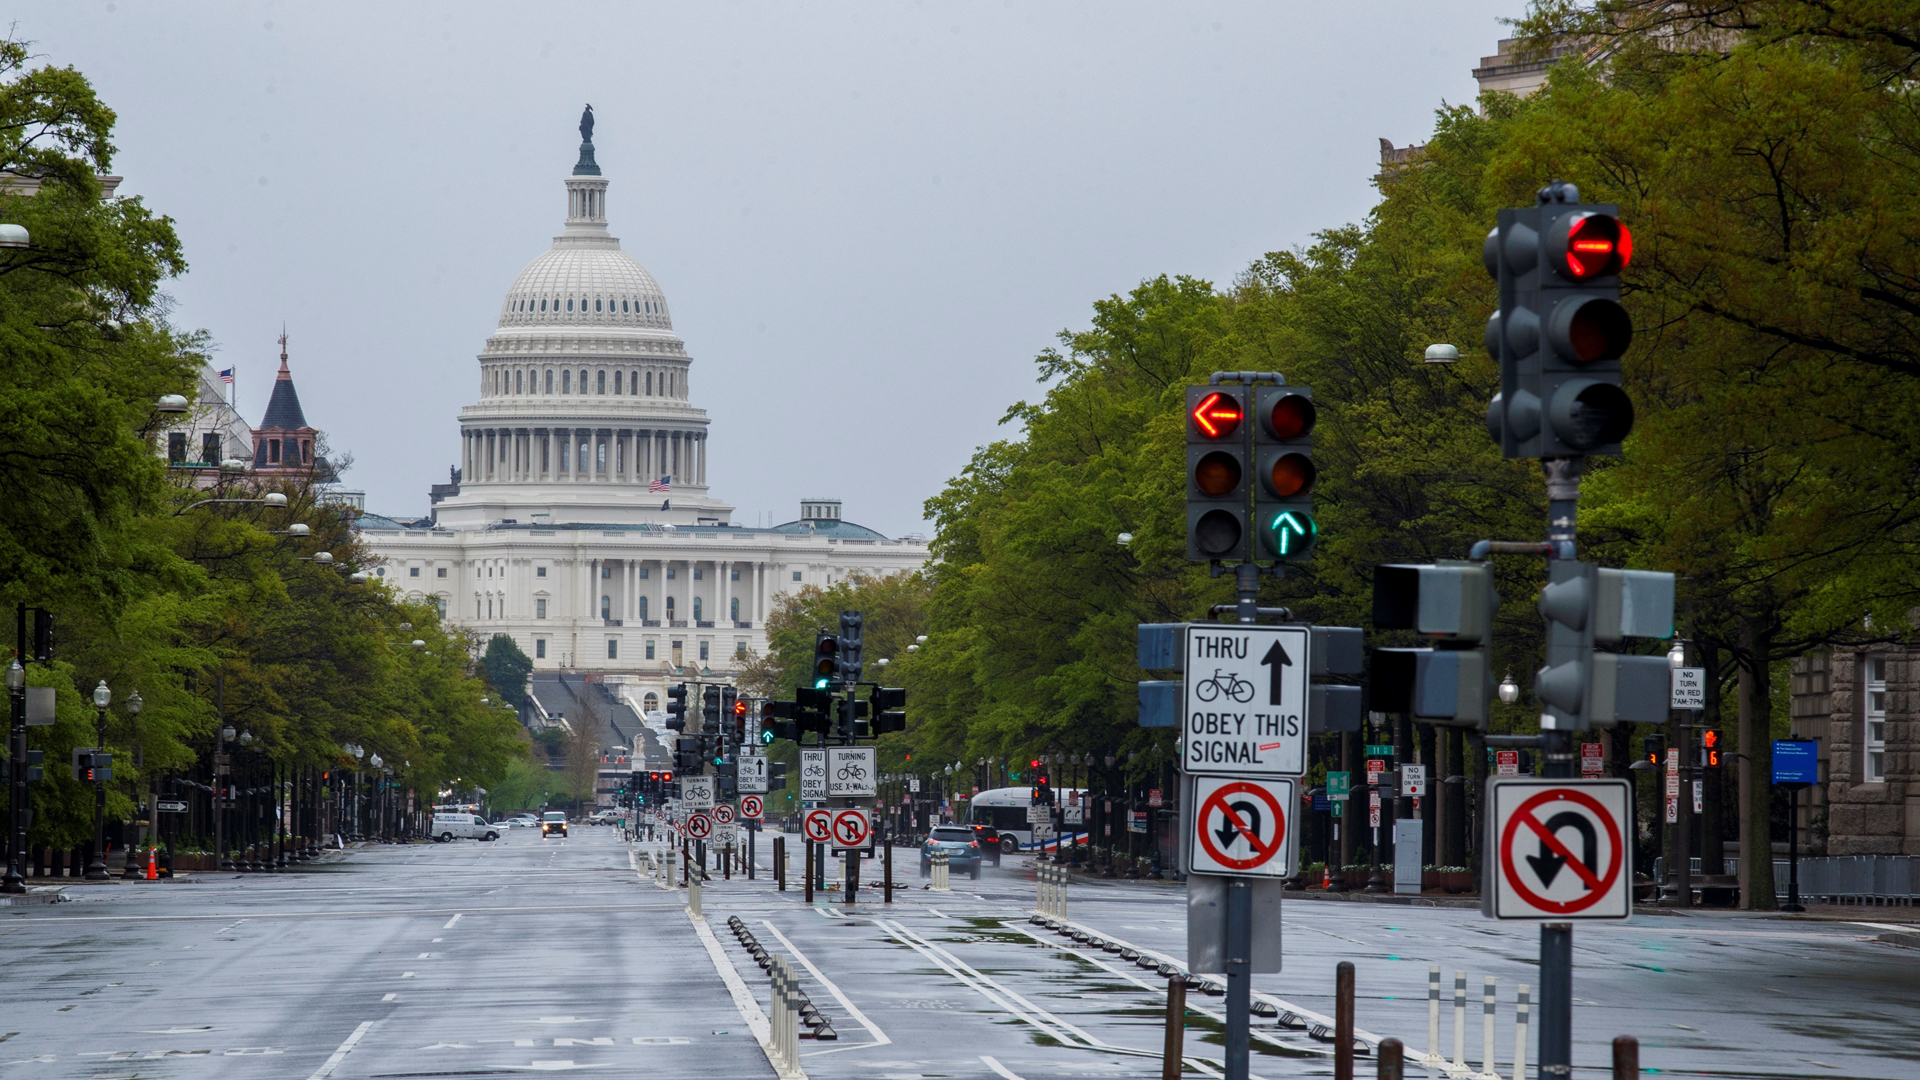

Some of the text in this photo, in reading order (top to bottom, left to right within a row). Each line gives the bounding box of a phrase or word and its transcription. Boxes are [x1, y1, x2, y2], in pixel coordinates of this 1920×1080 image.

[1195, 636, 1248, 659] THRU
[1191, 712, 1299, 737] OBEY THIS
[1191, 740, 1263, 764] SIGNAL
[1373, 746, 1380, 754] 11
[804, 752, 823, 761] THRU
[838, 752, 866, 761] TURNING
[1710, 750, 1717, 765] 6
[802, 779, 822, 788] OBEY
[830, 783, 843, 791] USE
